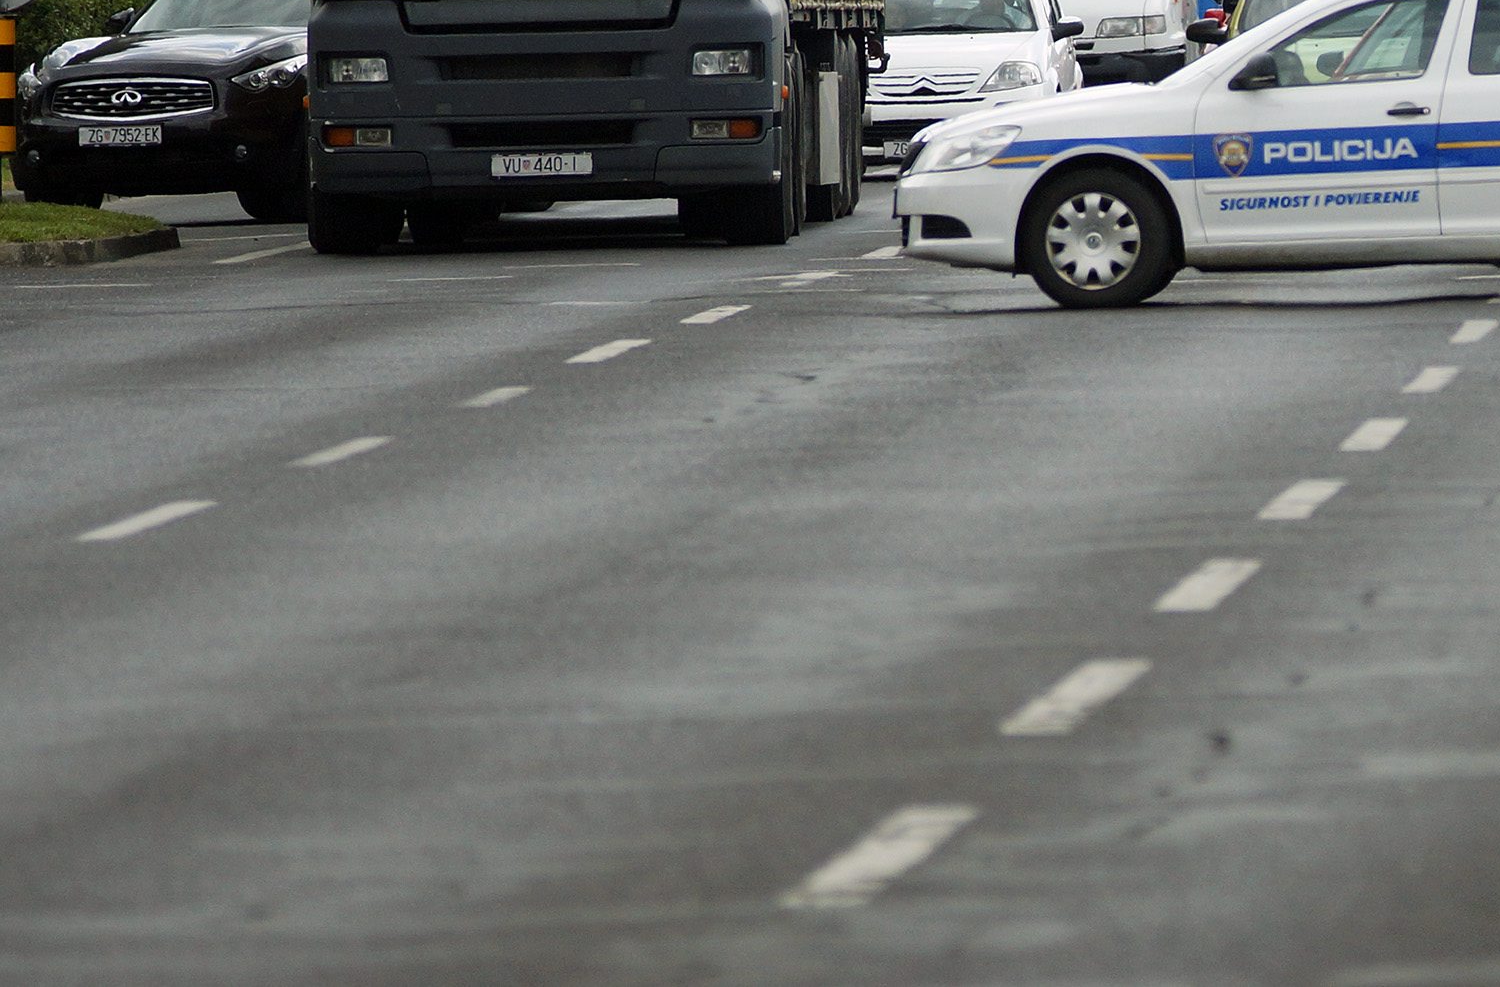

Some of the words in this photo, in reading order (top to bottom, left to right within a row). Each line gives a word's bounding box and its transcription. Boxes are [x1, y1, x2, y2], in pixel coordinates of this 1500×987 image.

[88, 129, 104, 143] ZG
[111, 127, 160, 143] 7952-EK
[893, 142, 908, 156] ZG
[1263, 137, 1419, 164] POLICIJA
[502, 158, 521, 174] VU
[1220, 195, 1310, 211] SIGURNOST
[1313, 195, 1320, 207] I
[1324, 190, 1420, 207] POVJERENJE
